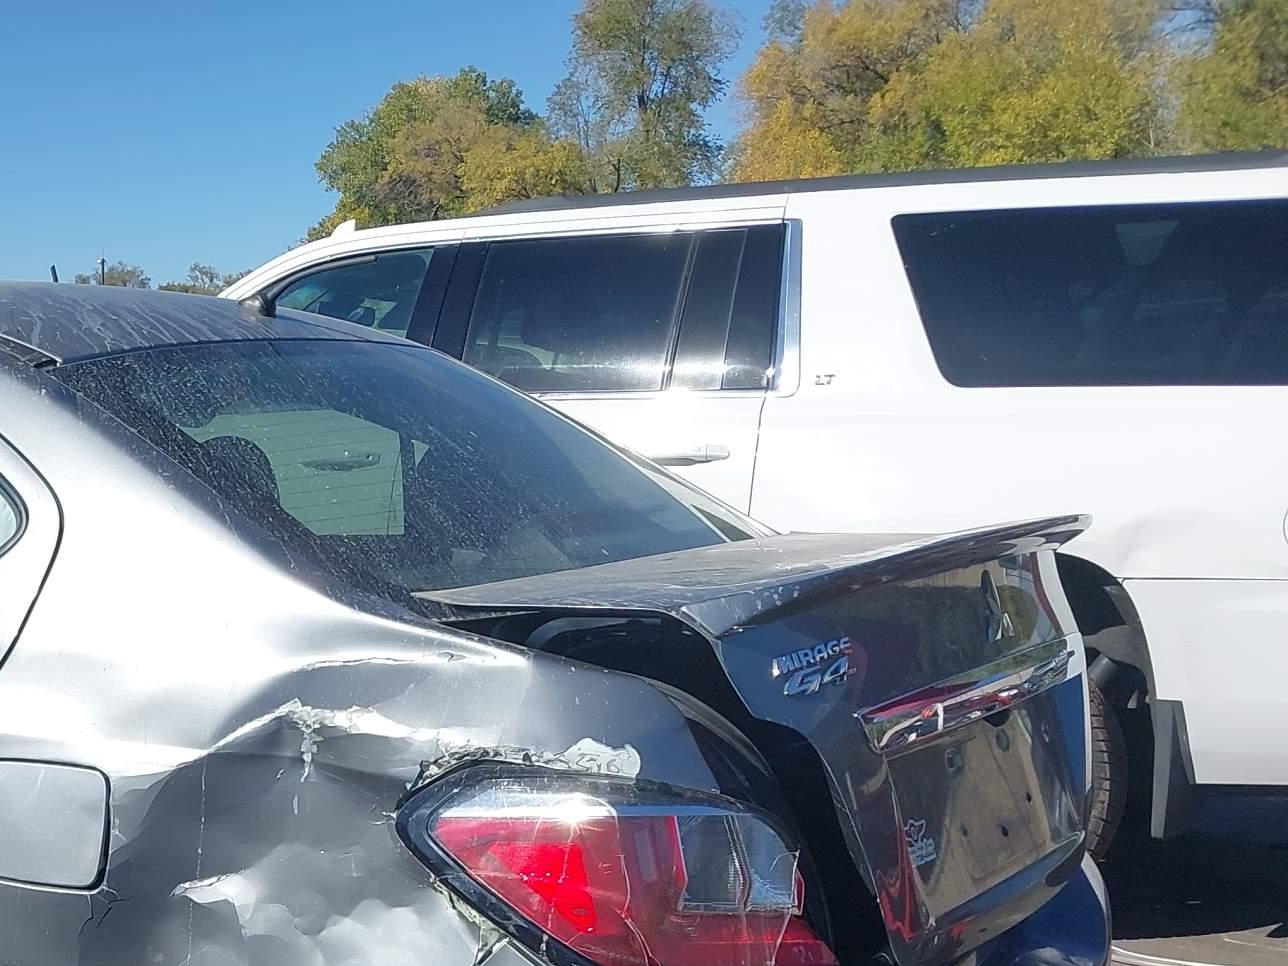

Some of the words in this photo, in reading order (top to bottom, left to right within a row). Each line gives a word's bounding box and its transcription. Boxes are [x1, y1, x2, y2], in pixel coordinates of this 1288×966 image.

[815, 374, 836, 385] LT
[770, 636, 853, 678] MIRAGE
[783, 656, 857, 696] G4
